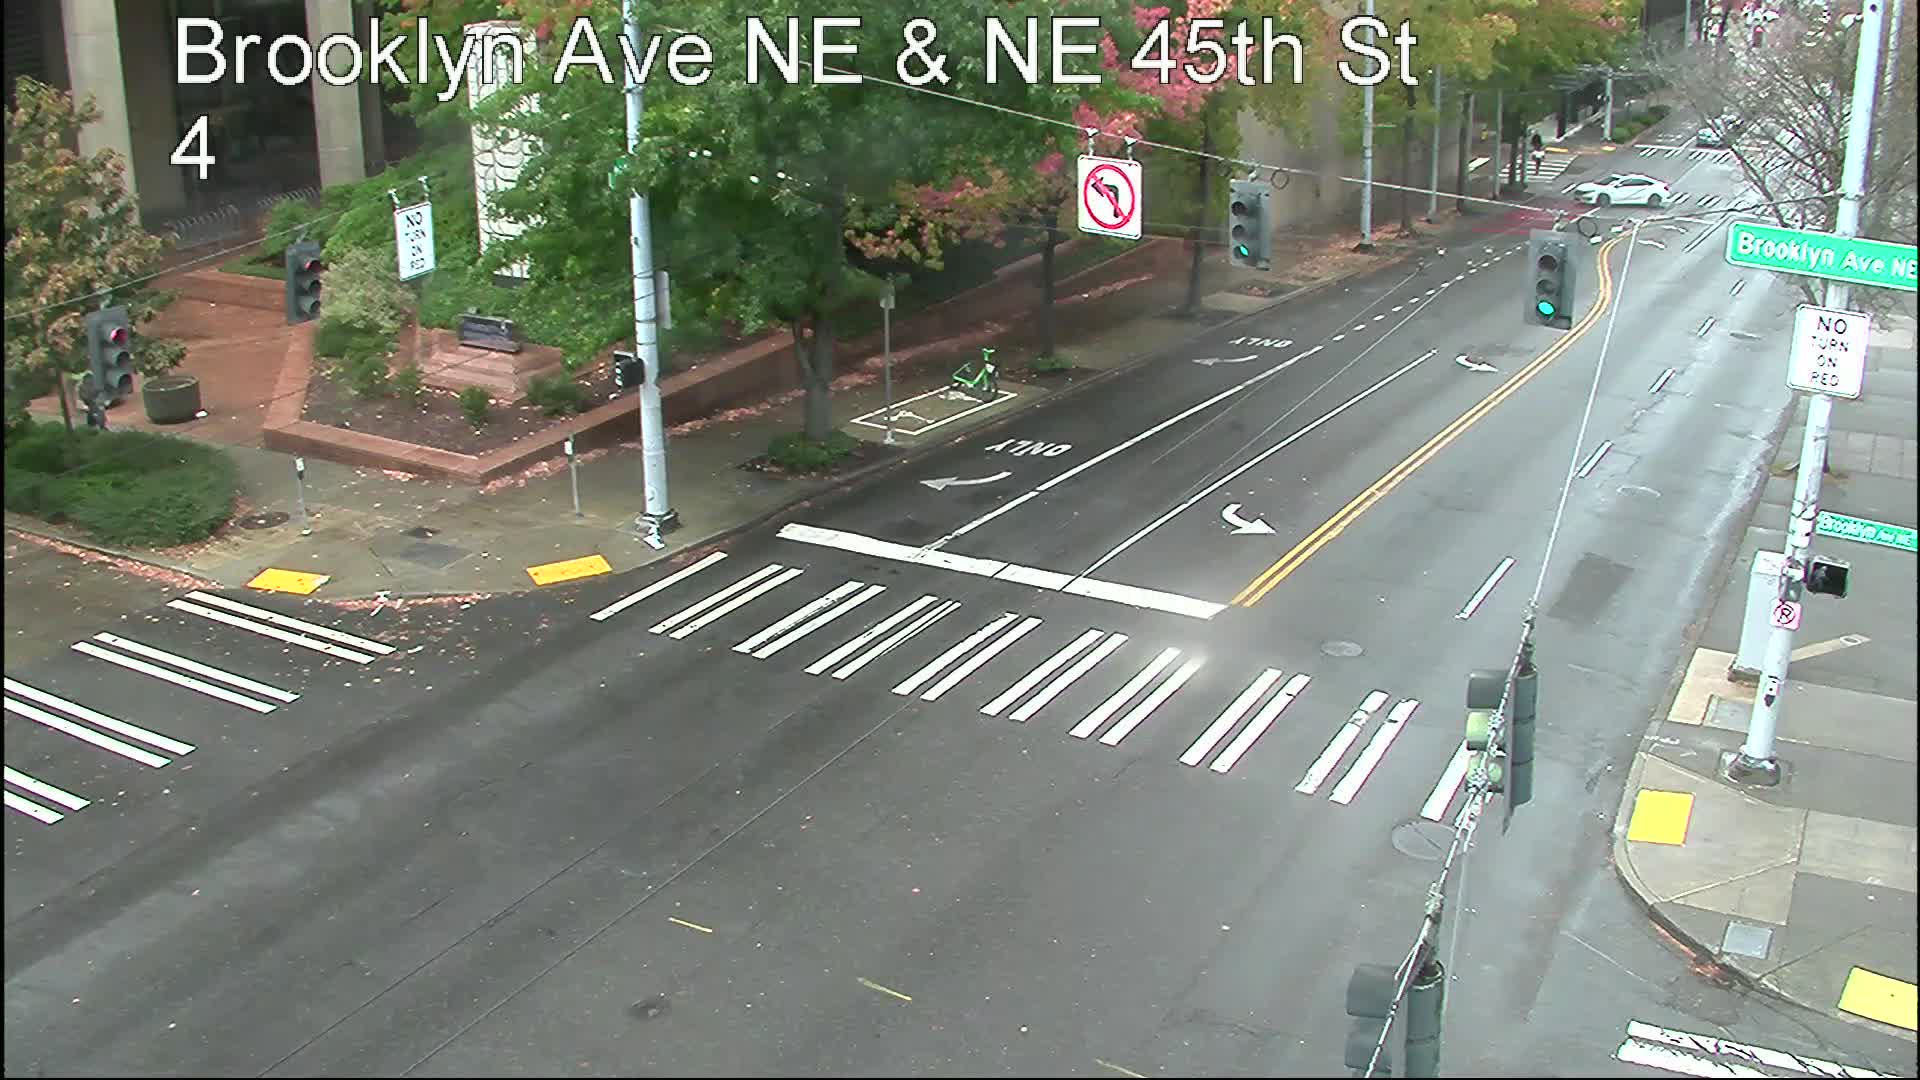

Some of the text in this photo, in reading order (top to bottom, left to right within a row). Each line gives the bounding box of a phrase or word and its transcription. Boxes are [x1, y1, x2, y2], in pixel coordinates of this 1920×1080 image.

[405, 211, 423, 228] NO
[1738, 231, 1917, 280] Brooklyn Ave NE
[1817, 315, 1847, 335] NO
[1227, 336, 1294, 348] ONLY
[1811, 335, 1849, 352] TURN
[1816, 354, 1838, 368] ON
[1810, 371, 1840, 387] RED
[984, 439, 1073, 457] ONLY
[1819, 514, 1877, 540] Brooklyn
